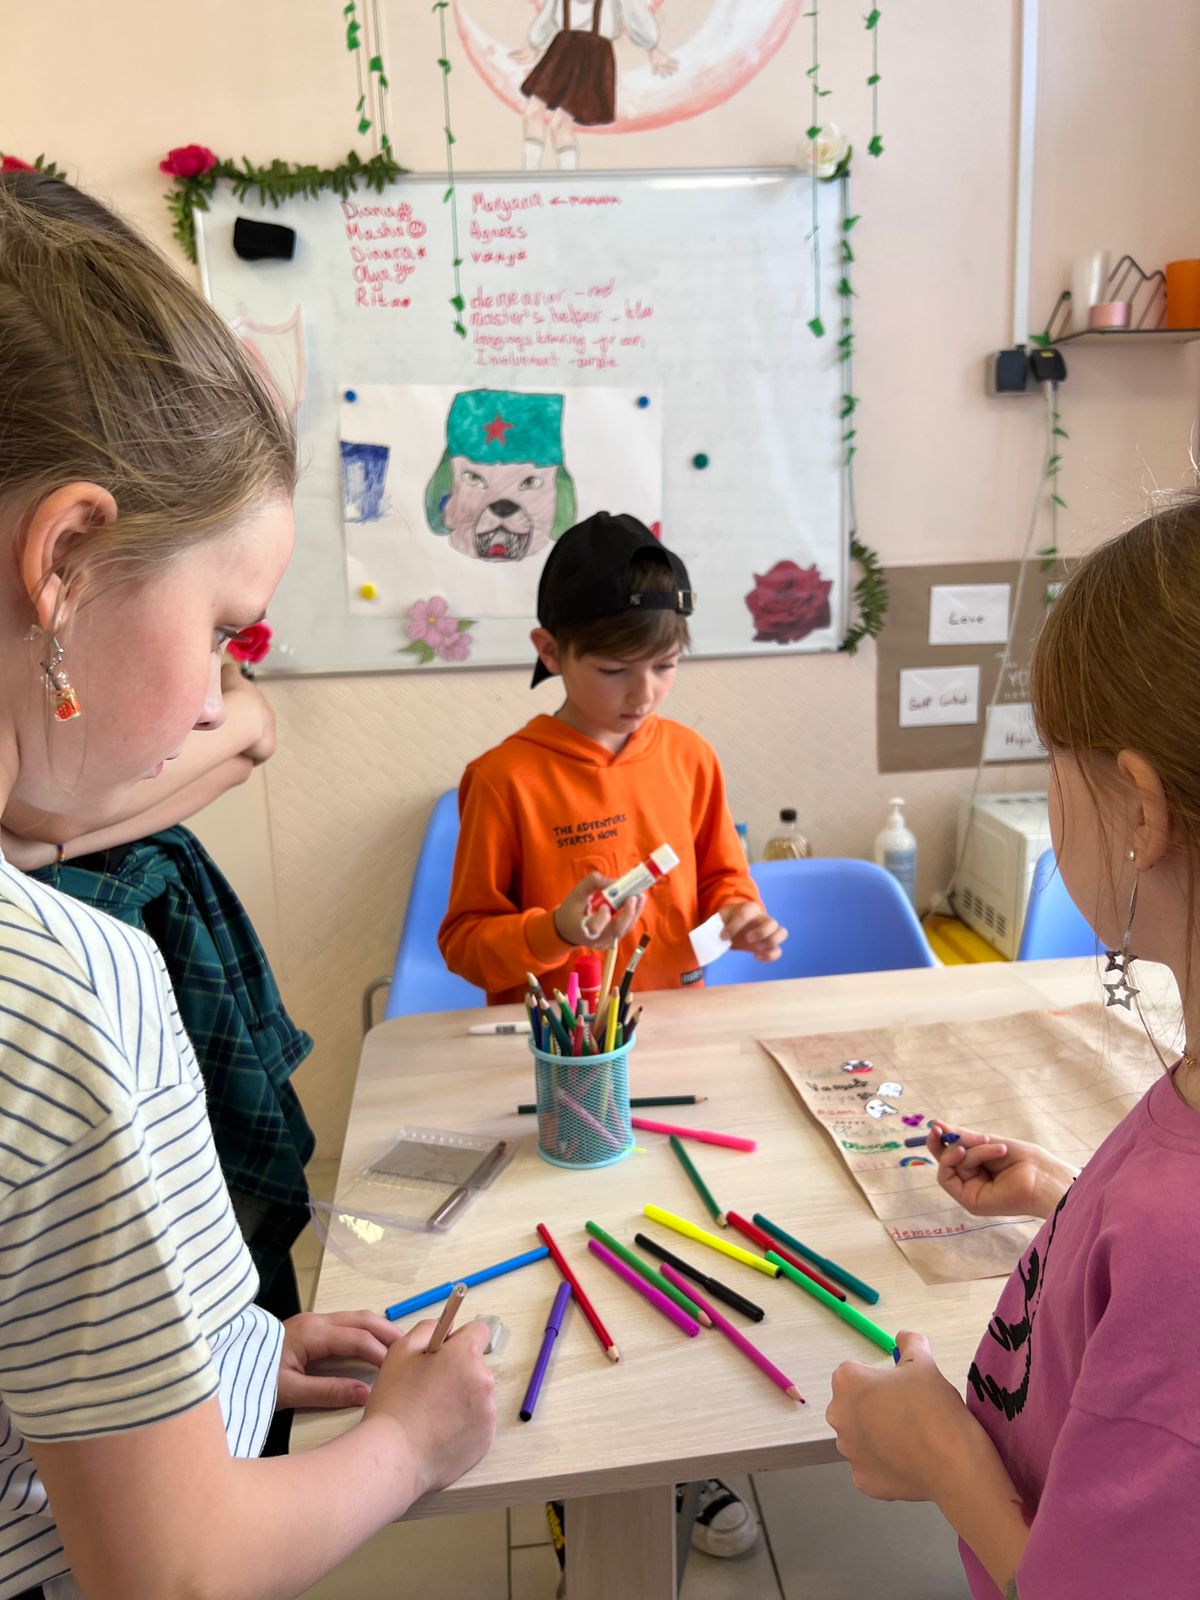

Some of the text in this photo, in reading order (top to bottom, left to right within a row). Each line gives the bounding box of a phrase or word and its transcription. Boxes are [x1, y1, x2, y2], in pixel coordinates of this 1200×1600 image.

[552, 813, 627, 837] THE ADVENTURE
[556, 828, 618, 849] STARTS NOW
